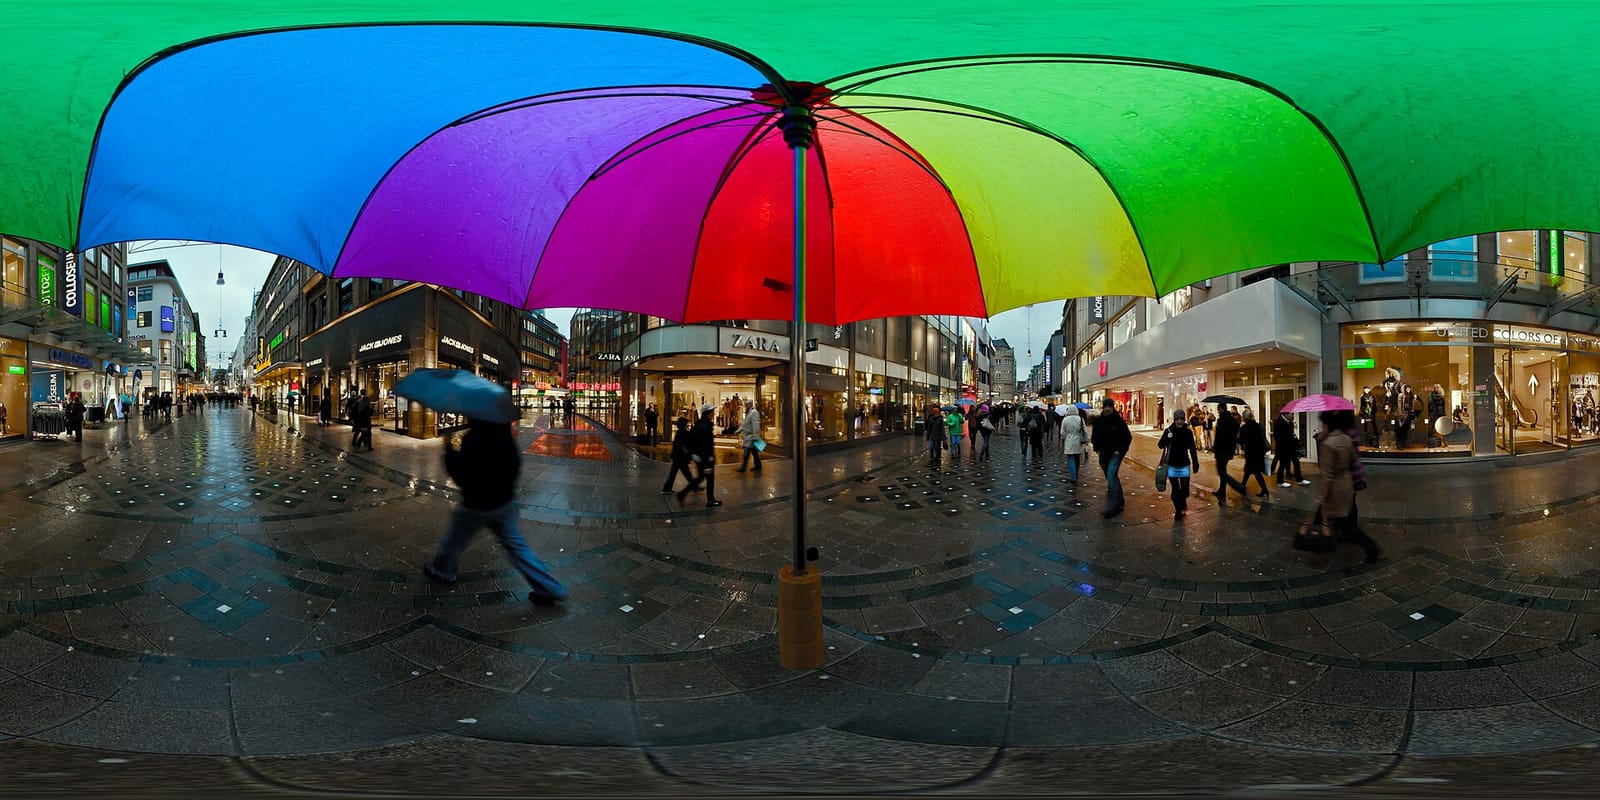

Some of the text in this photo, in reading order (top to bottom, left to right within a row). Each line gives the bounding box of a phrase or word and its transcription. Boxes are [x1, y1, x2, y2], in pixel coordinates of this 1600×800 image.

[359, 341, 375, 352] JACK
[380, 335, 402, 346] JONES
[441, 335, 456, 346] JACK
[732, 334, 780, 353] ZARA
[1436, 327, 1489, 338] UNITED
[1493, 329, 1541, 343] COLORS
[1543, 333, 1559, 345] OF
[598, 353, 621, 361] ZARA
